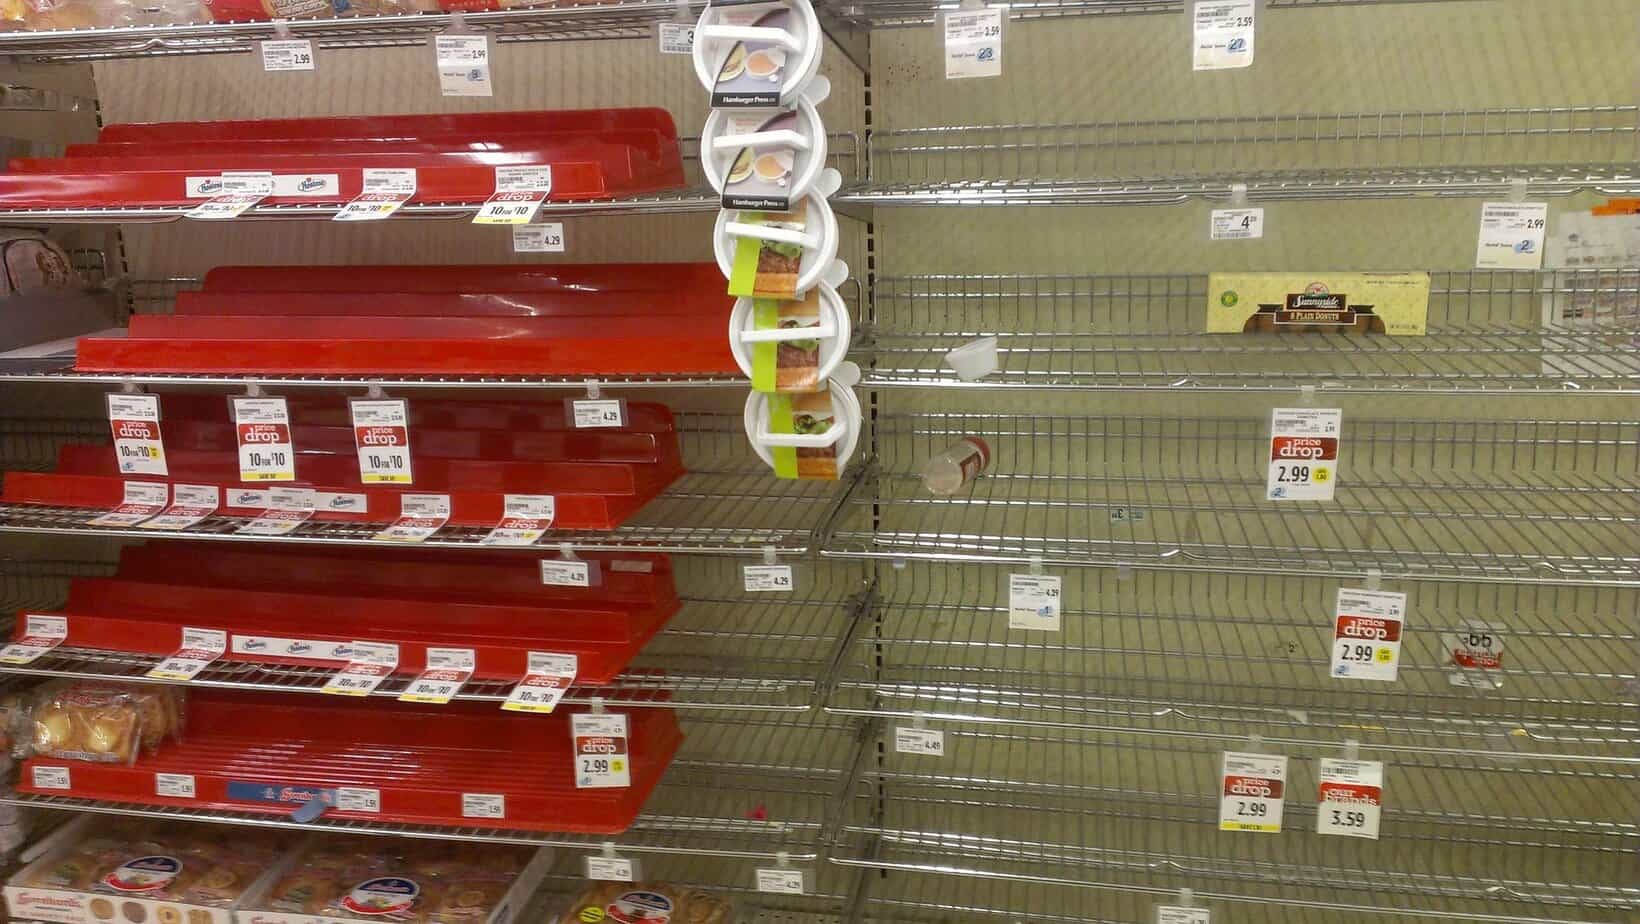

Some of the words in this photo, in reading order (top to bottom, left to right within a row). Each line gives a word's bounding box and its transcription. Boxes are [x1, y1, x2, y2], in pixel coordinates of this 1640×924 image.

[293, 53, 311, 65] 2.99
[490, 206, 503, 215] 10
[1527, 218, 1545, 230] 2.99
[1520, 240, 1530, 251] 2
[120, 423, 151, 441] drop
[244, 427, 280, 446] drop
[363, 428, 397, 447] drop
[1279, 440, 1324, 461] drop
[1294, 439, 1322, 447] price
[120, 445, 131, 457] 10
[249, 452, 261, 467] 10
[369, 455, 381, 469] 10
[1277, 465, 1310, 483] 2.99
[1344, 619, 1387, 640] drop
[1359, 619, 1385, 627] price
[1341, 644, 1373, 662] 2.99
[583, 759, 609, 773] 2.99
[1231, 779, 1272, 798] drop
[1238, 801, 1267, 816] 2.99
[1332, 810, 1365, 828] 3.59
